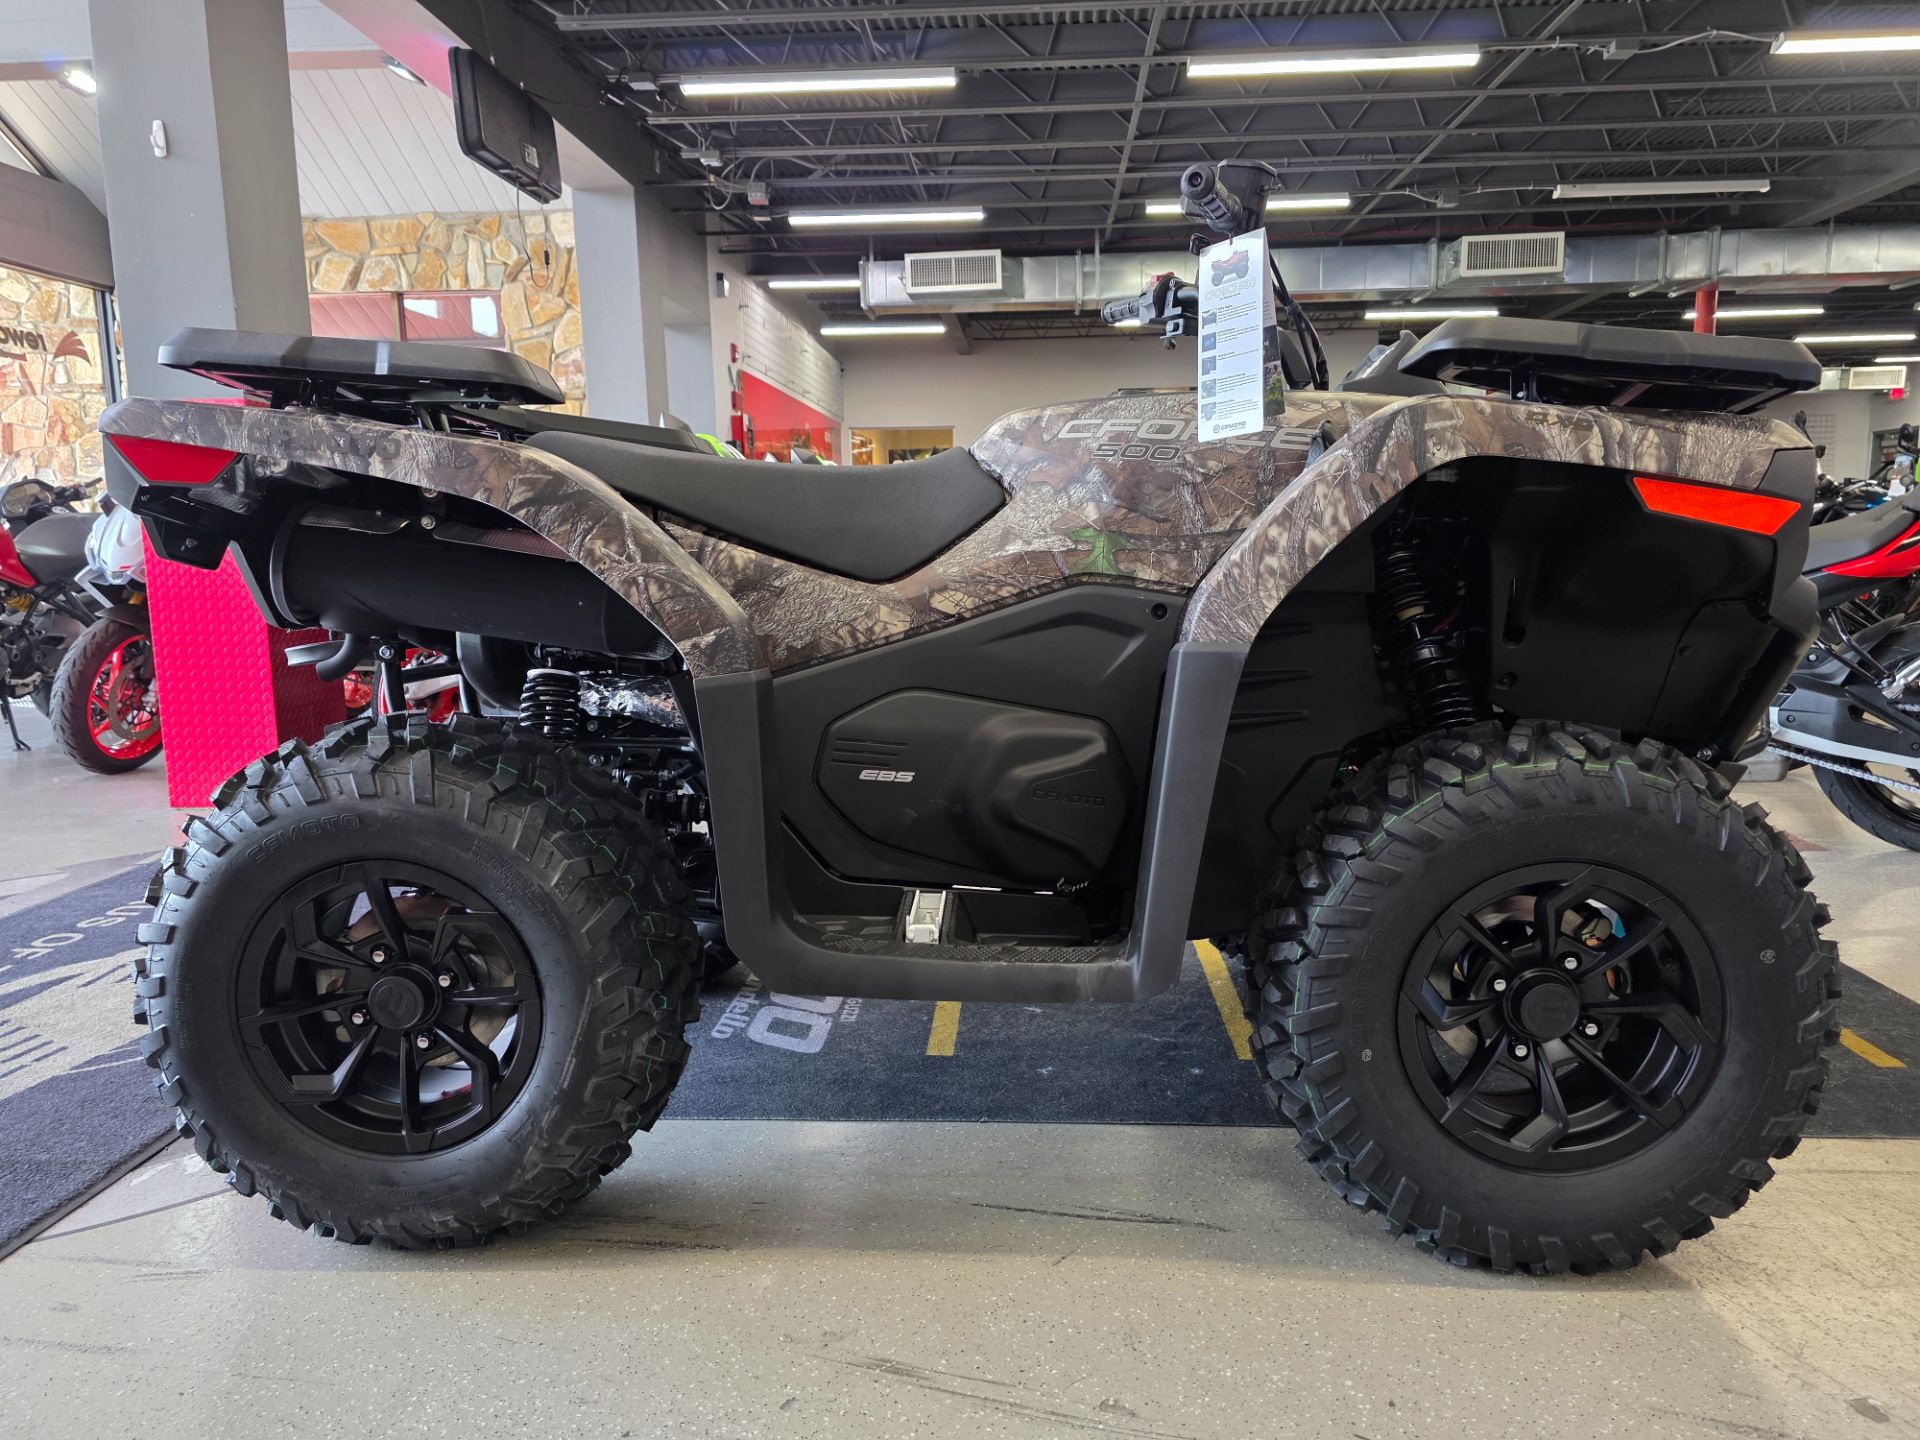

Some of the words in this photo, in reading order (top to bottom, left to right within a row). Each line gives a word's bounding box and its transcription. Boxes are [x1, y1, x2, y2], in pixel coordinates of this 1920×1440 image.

[1090, 442, 1182, 462] 500
[859, 769, 916, 783] EBS
[1033, 788, 1105, 807] CFMOTO
[246, 813, 361, 864] CFMOTO
